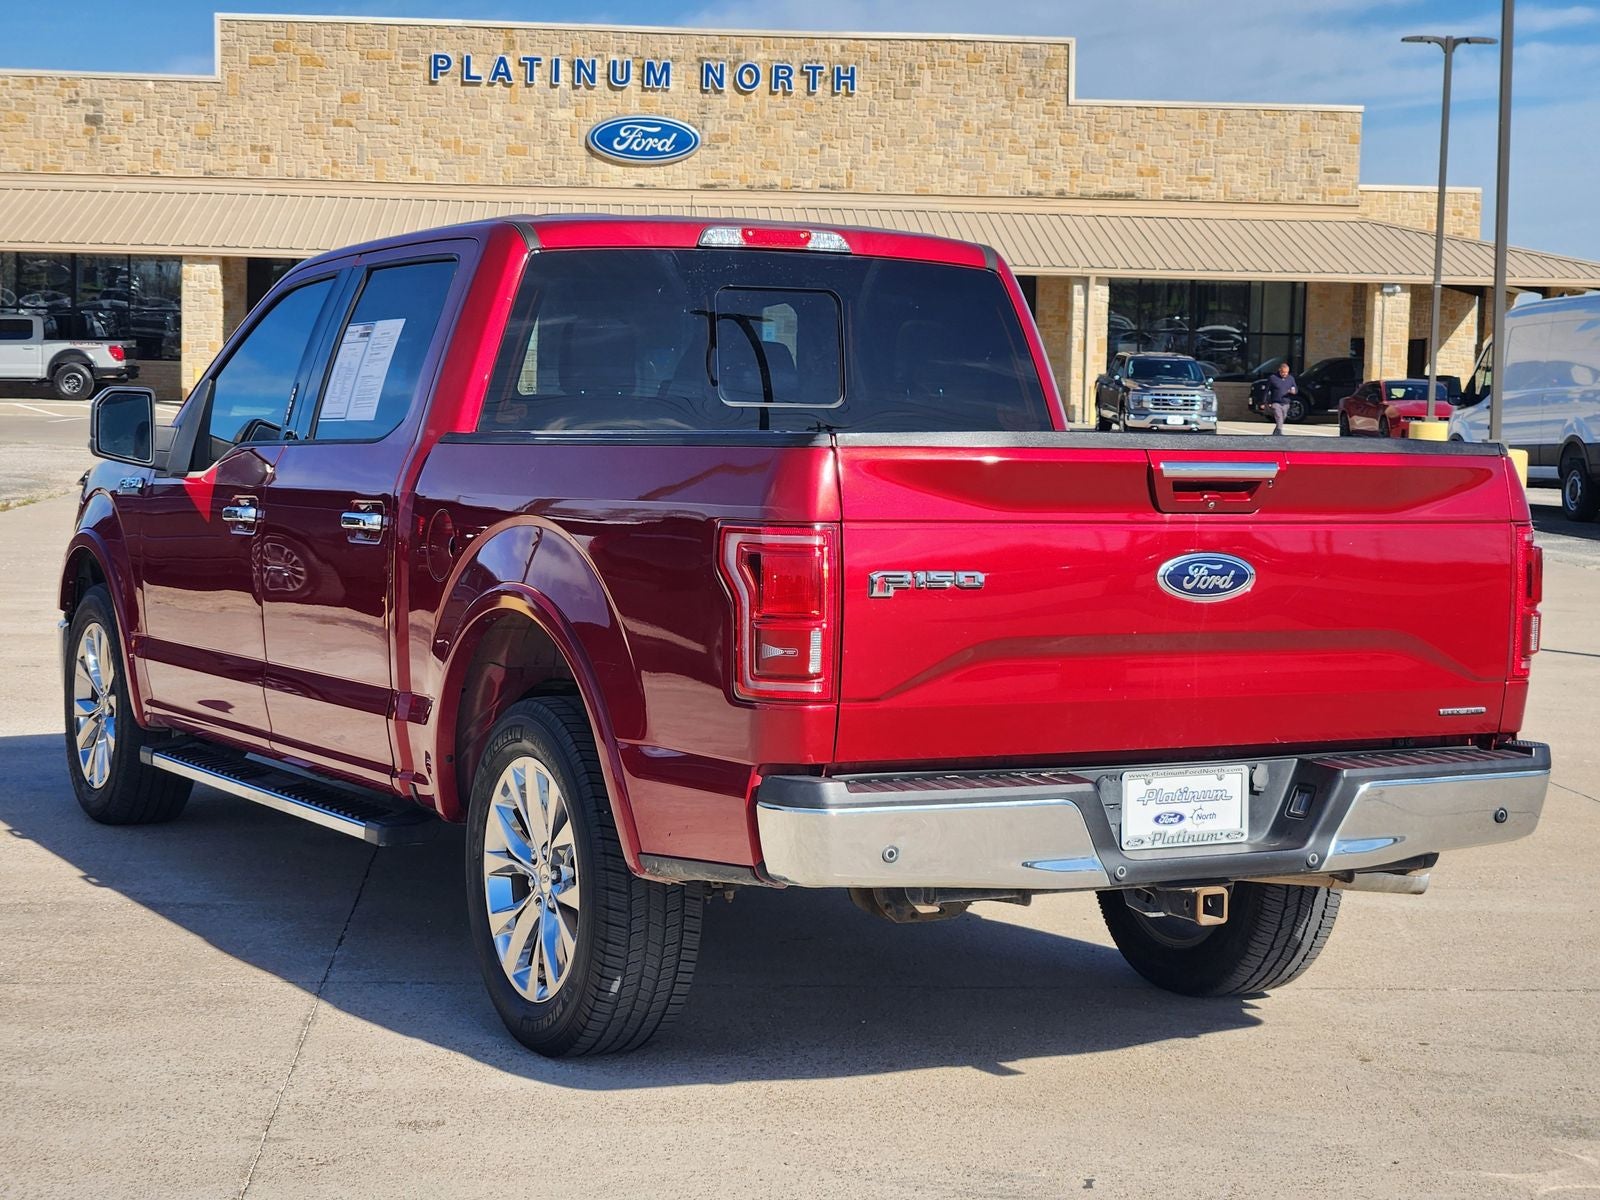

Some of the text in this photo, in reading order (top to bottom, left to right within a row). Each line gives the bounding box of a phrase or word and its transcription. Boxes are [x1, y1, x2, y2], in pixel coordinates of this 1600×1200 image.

[430, 53, 858, 95] PLATINUM NORTH
[612, 124, 677, 153] Ford
[1182, 563, 1236, 590] Ford
[484, 727, 522, 768] MICHELIN
[1137, 786, 1233, 806] Platinum
[1158, 811, 1217, 824] Ford North
[1151, 829, 1220, 847] Platinum
